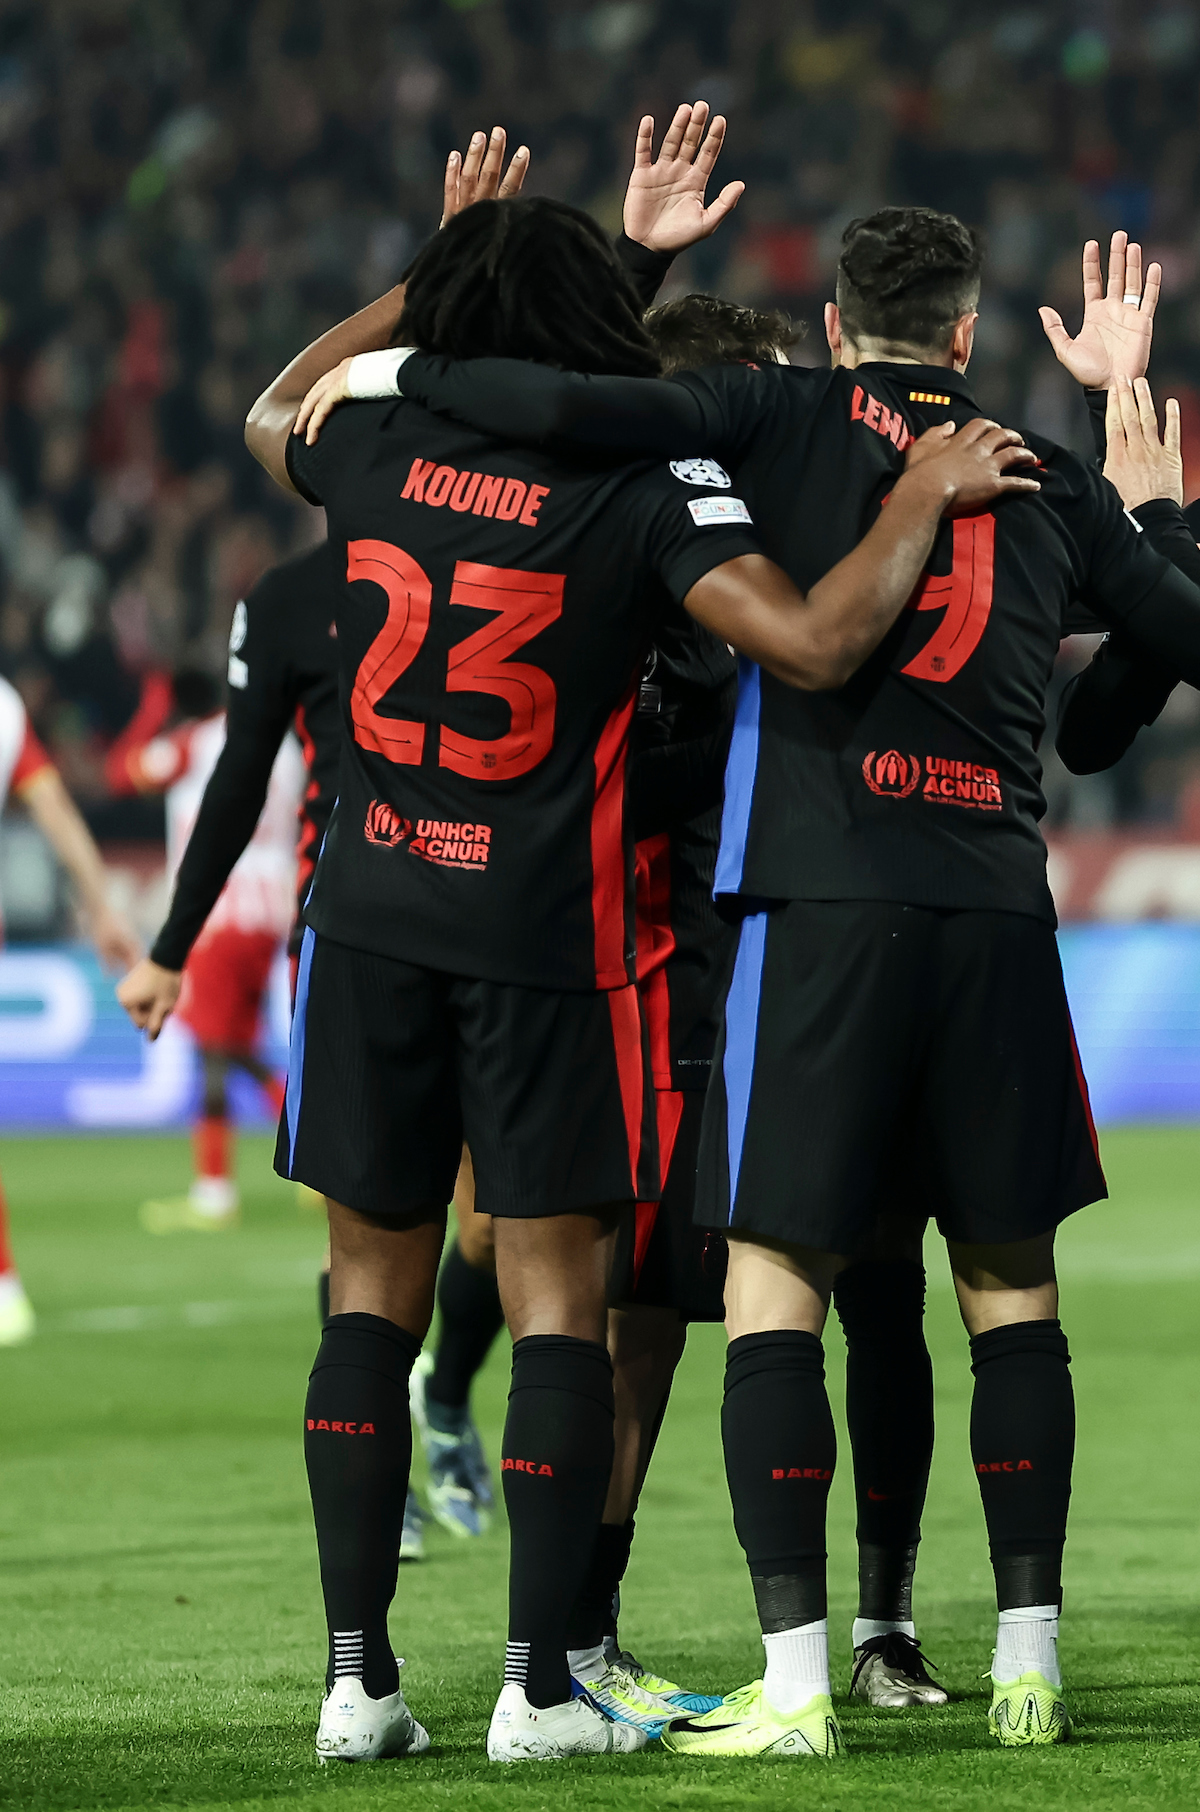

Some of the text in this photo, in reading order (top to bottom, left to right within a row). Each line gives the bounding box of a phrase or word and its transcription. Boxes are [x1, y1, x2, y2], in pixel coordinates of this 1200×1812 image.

[400, 457, 550, 527] KOUNDE
[346, 538, 567, 781] 23
[923, 755, 1000, 785] UNHCR
[922, 775, 1003, 804] ACNUR
[415, 818, 493, 844] UNHCR
[409, 837, 491, 863] ACNUR
